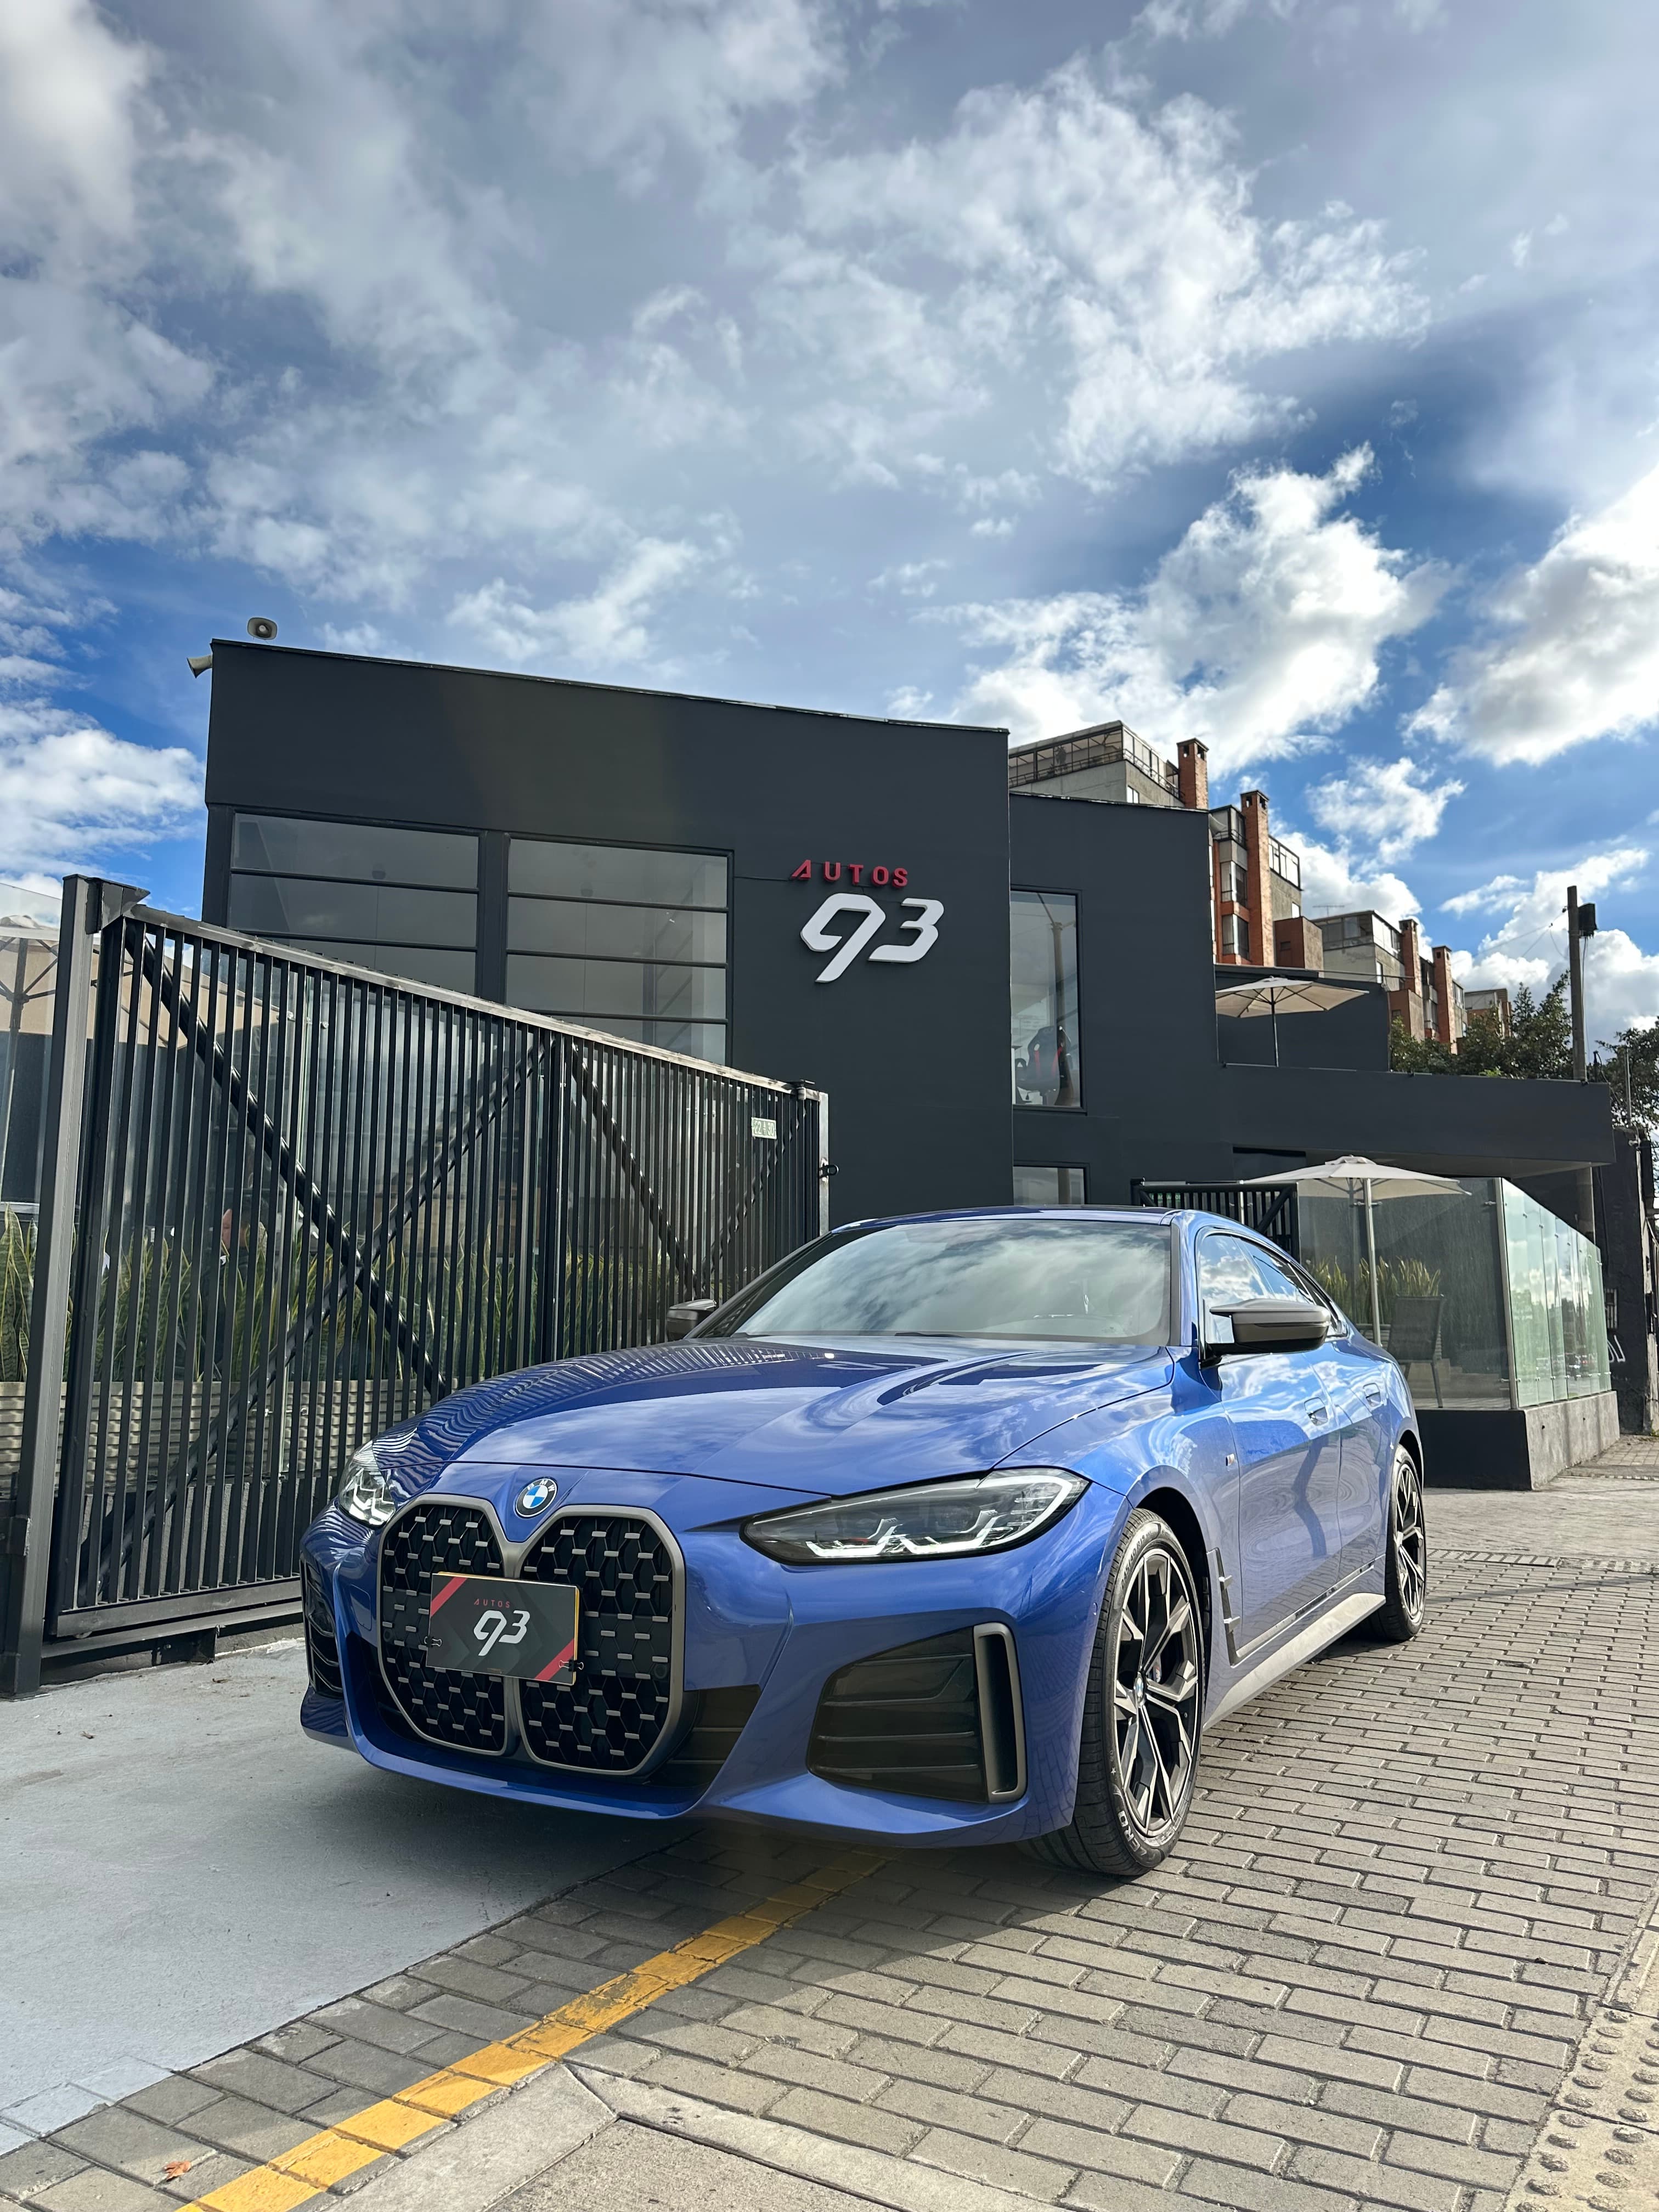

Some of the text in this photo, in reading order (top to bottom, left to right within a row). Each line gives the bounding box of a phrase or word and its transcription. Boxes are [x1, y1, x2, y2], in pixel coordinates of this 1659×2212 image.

[791, 859, 908, 888] AUTOS
[800, 893, 944, 983] 93
[527, 1479, 555, 1492] BMW
[473, 1598, 510, 1608] AUTOS
[473, 1610, 531, 1656] 93
